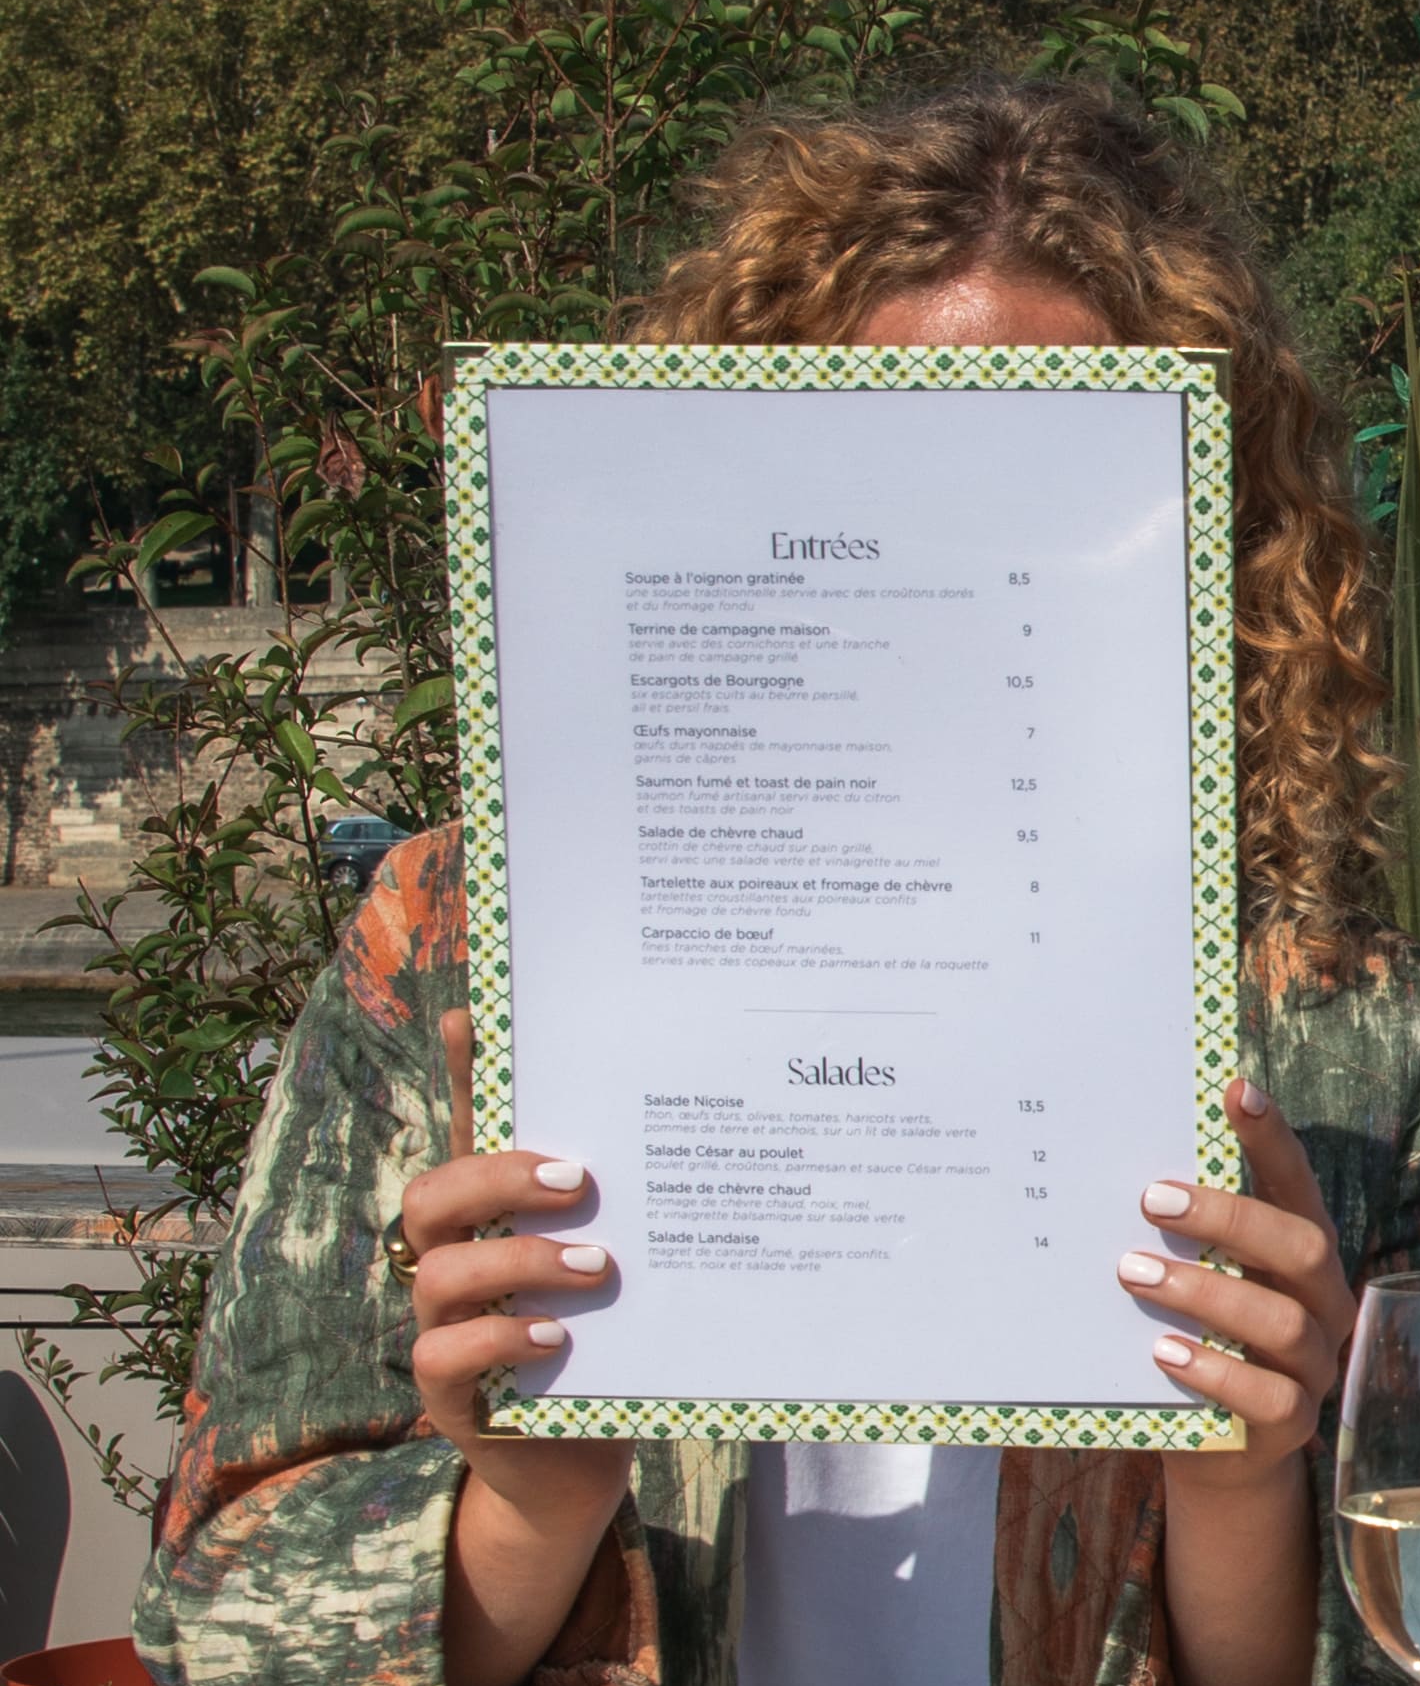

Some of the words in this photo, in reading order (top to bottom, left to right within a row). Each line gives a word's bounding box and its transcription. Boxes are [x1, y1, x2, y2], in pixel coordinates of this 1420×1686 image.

[771, 531, 881, 560] Entrées
[625, 571, 670, 586] Soupe
[673, 571, 682, 584] à
[746, 572, 805, 587] gratinée
[1008, 572, 1031, 586] 8,5
[627, 623, 676, 635] Terrine
[679, 623, 698, 636] de
[701, 625, 776, 638] campagne
[780, 624, 831, 636] maison
[1022, 624, 1033, 637] 9
[630, 674, 700, 688] Escargots
[703, 674, 722, 687] de
[726, 674, 805, 690] Bourgogne
[1006, 675, 1034, 689] 10,5
[633, 724, 670, 737] Œufs
[674, 725, 757, 739] mayonnaise
[1027, 727, 1035, 739] 7
[635, 775, 693, 788] Saumon
[696, 775, 732, 788] fumé
[736, 777, 750, 788] et
[754, 776, 790, 789] toast
[793, 776, 812, 789] de
[815, 777, 846, 791] pain
[849, 777, 877, 789] noir
[1011, 778, 1038, 792] 12,5
[641, 926, 711, 940] Carpaccio
[714, 927, 732, 940] de
[736, 927, 774, 941] bœuf
[1030, 931, 1040, 944] 11
[787, 1056, 896, 1087] Salades
[644, 1093, 690, 1107] Salade
[694, 1095, 744, 1109] Niçoise
[1018, 1099, 1045, 1114] 13,5
[644, 1159, 685, 1171] poulet
[784, 1163, 847, 1174] parmesan
[849, 1163, 863, 1174] et
[866, 1164, 904, 1174] sauce
[906, 1162, 943, 1175] César
[944, 1165, 991, 1175] maison
[648, 1230, 694, 1244] Salade
[698, 1232, 760, 1245] Landaise
[1034, 1236, 1049, 1248] 14
[699, 1261, 726, 1270] noix
[729, 1261, 742, 1271] et
[746, 1261, 786, 1271] salade
[790, 1262, 822, 1272] verte
